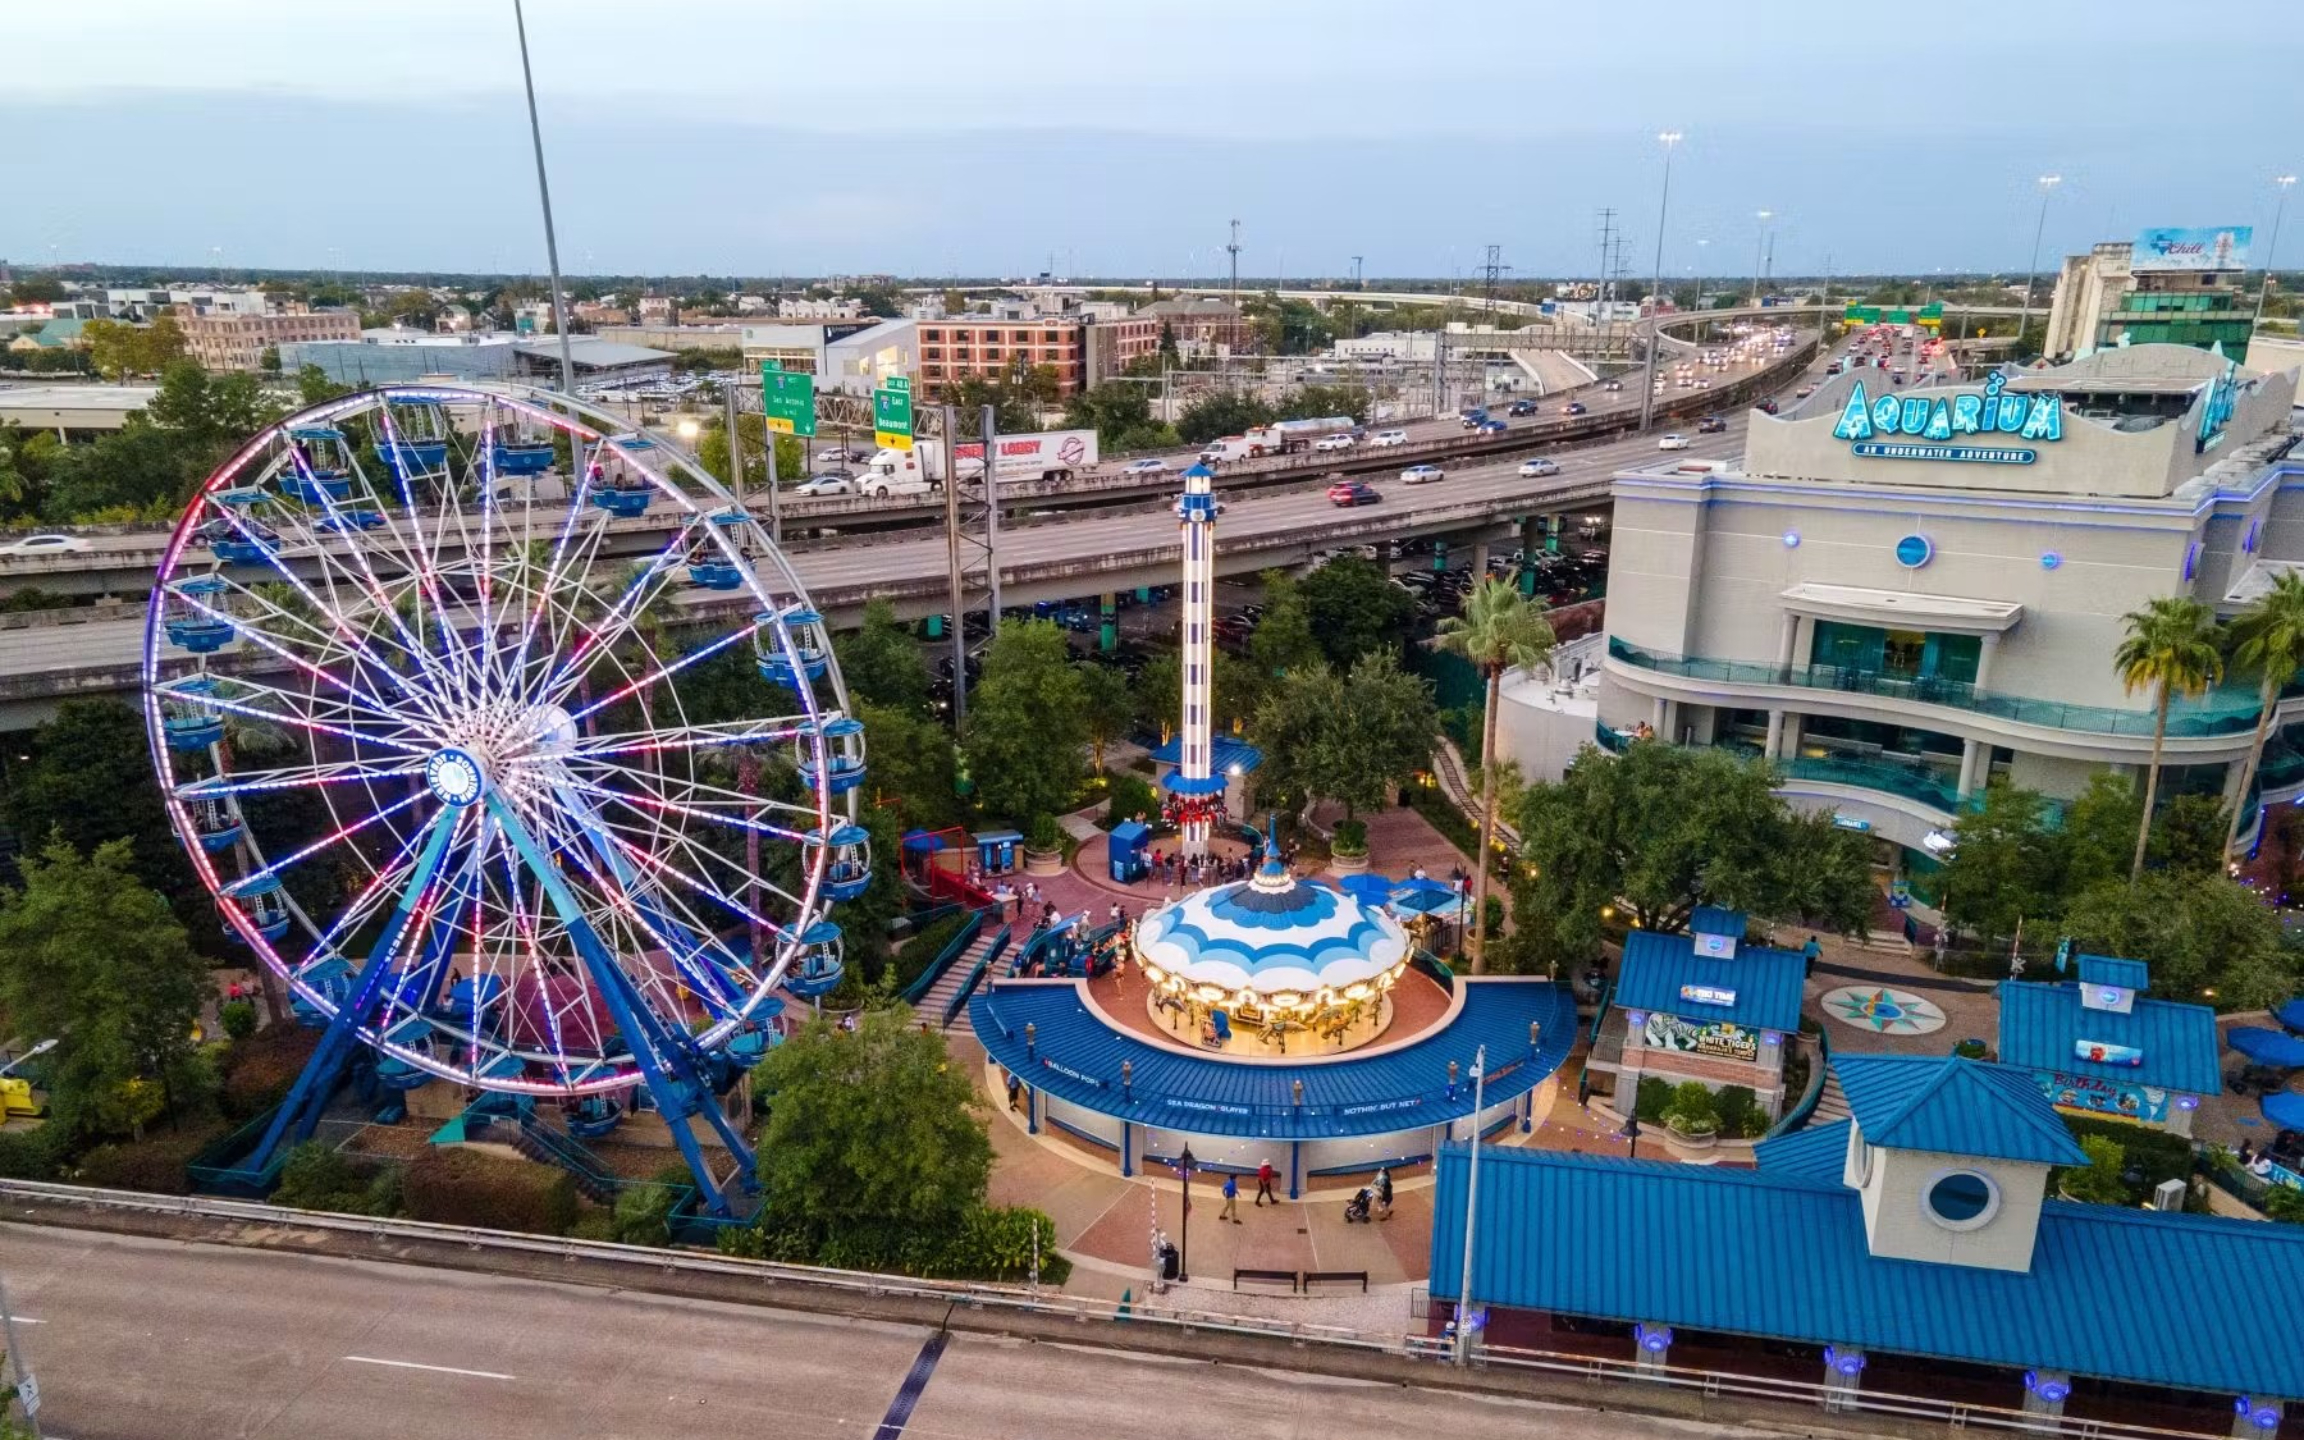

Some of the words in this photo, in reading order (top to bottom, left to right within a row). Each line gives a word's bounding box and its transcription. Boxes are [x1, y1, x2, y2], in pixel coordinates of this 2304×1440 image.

[2168, 242, 2205, 255] Chill
[1833, 372, 2062, 441] AQUARIUM
[878, 417, 908, 430] Beaumont
[1001, 440, 1041, 456] LOBBY
[1884, 447, 1952, 458] UNDERWATER
[1960, 450, 2025, 460] ADVENTURE
[1699, 1034, 1725, 1046] WHITE
[1047, 1060, 1080, 1079] BALLOON
[2054, 1072, 2117, 1098] Birthday
[1167, 1099, 1182, 1107] SEA
[1183, 1101, 1216, 1110] DRAGON
[1220, 1105, 1249, 1115] SLAYER
[1380, 1102, 1397, 1111] BUT
[1399, 1100, 1415, 1108] NET
